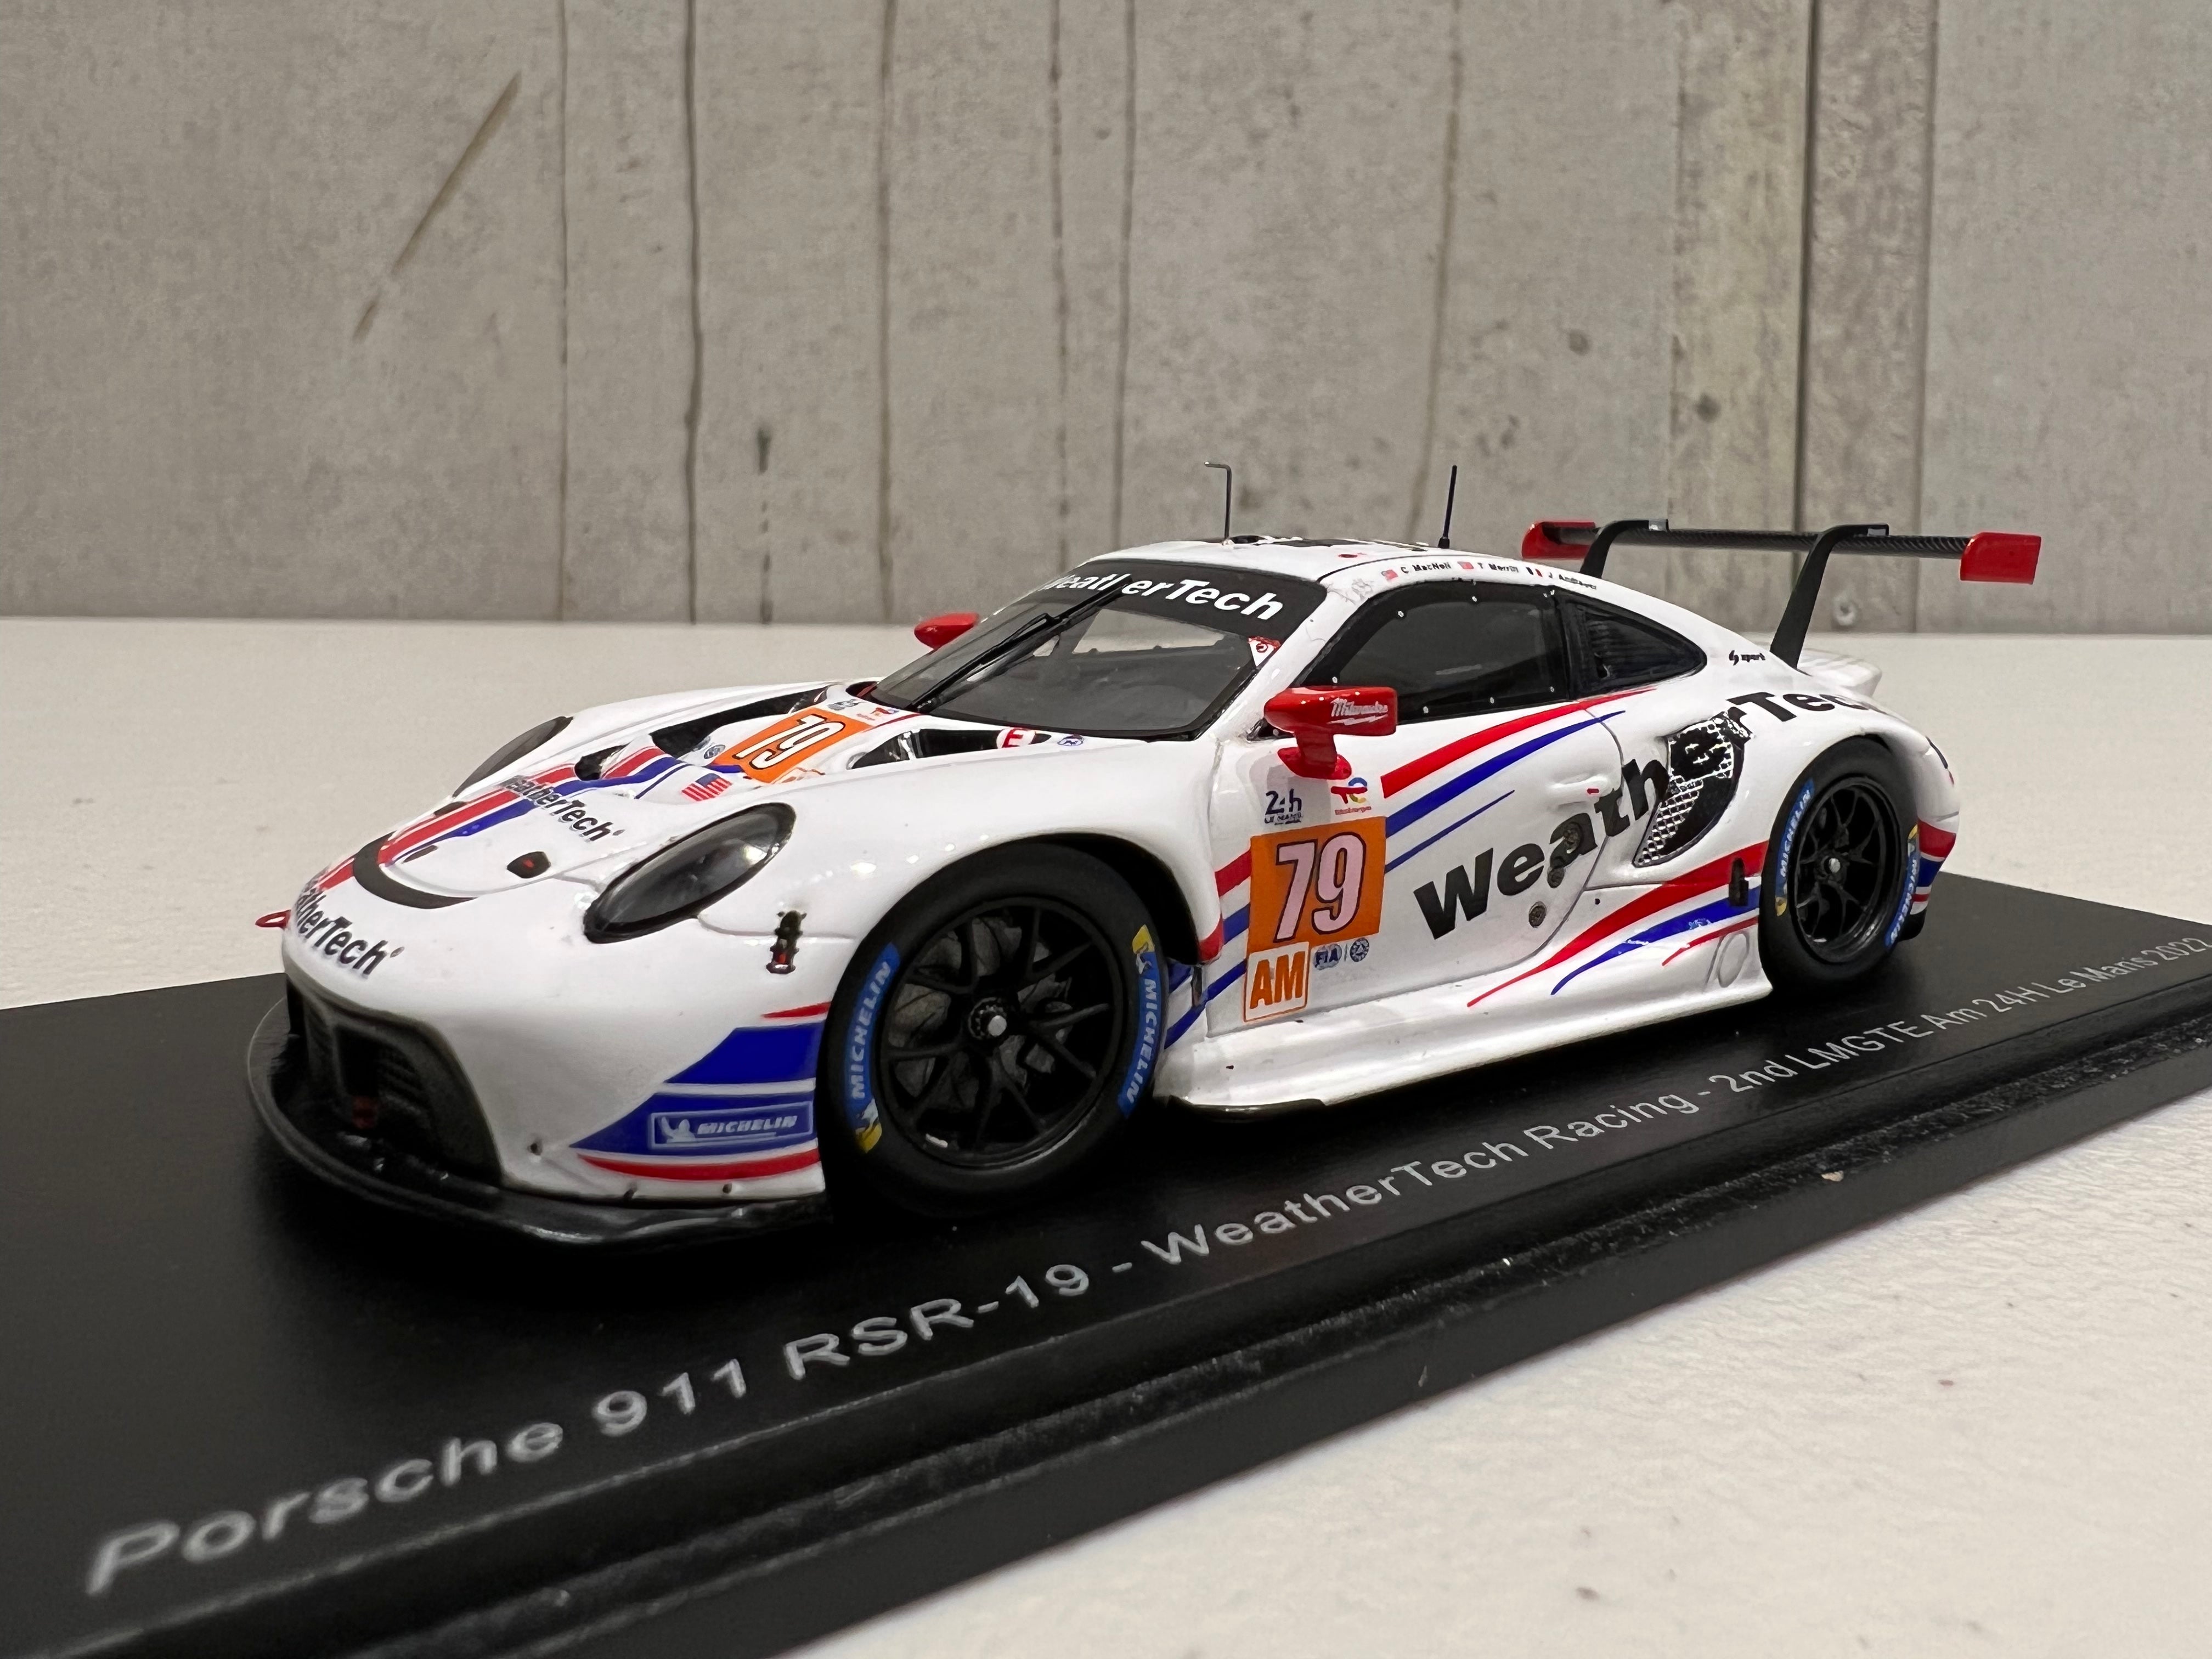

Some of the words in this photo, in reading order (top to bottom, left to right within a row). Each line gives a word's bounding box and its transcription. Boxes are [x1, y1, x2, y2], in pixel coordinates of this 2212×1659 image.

[732, 713, 845, 770] 79
[1002, 728, 1028, 748] E
[1413, 692, 1887, 940] WeathrTec
[295, 868, 388, 975] atherTech
[1273, 832, 1367, 944] 79
[850, 961, 890, 1099] MICHELIN
[1250, 951, 1305, 1009] AM
[1127, 978, 1158, 1104] MICHELIN
[697, 1115, 798, 1135] MICHELIN
[86, 1422, 564, 1595] Porsche
[592, 1358, 746, 1436] 911
[783, 1263, 1089, 1380] RSR-19
[1112, 1262, 1132, 1272] -
[1141, 1142, 1528, 1265] WeatherTech
[1523, 1091, 1700, 1149] Racing
[1708, 1059, 1798, 1092] 2nd
[1785, 1021, 1934, 1069] LMGTE
[1921, 1008, 1988, 1030] Am
[1972, 986, 2050, 1012] 24H
[2031, 982, 2086, 994] Le
[2141, 938, 2212, 961] 2022
